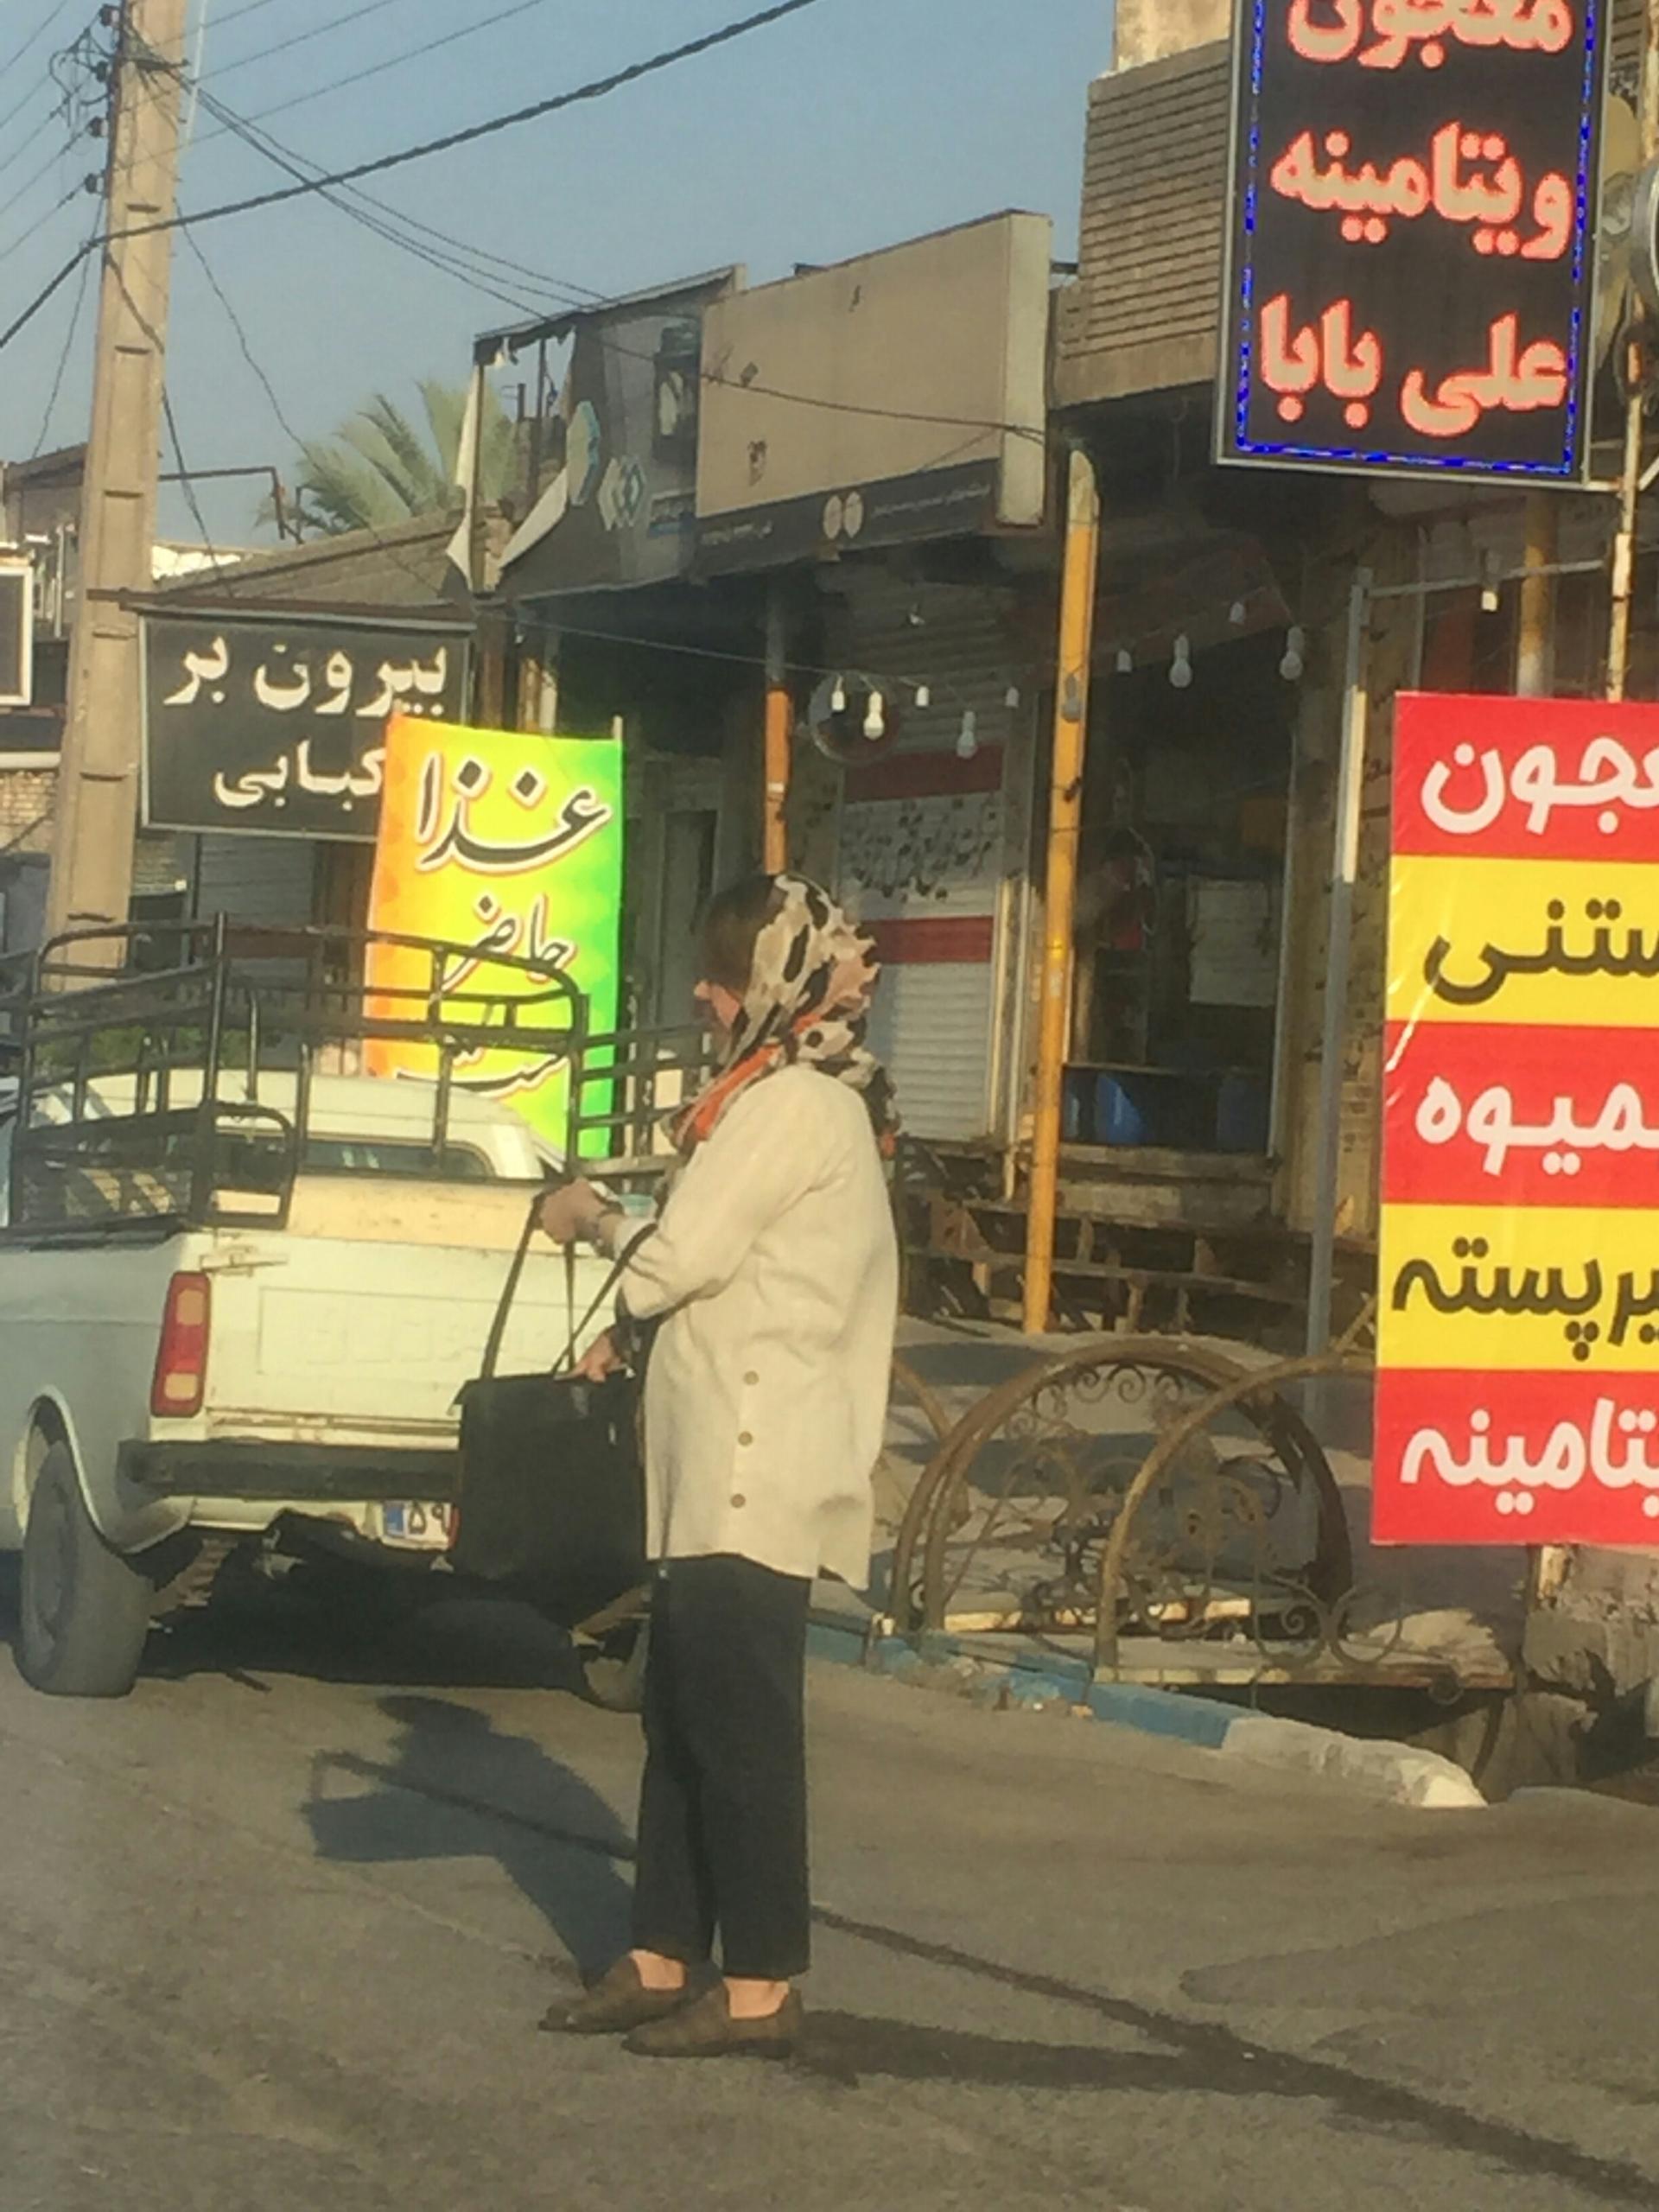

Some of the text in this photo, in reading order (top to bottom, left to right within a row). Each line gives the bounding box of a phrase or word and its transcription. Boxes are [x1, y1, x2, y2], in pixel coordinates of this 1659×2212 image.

[1270, 120, 1573, 259] ویتامینه
[1259, 292, 1568, 438] علی بابا
[163, 635, 448, 718] بیرون بر
[214, 740, 386, 810] کبابی
[415, 750, 610, 874] غذا
[1414, 1075, 1659, 1177] میوه
